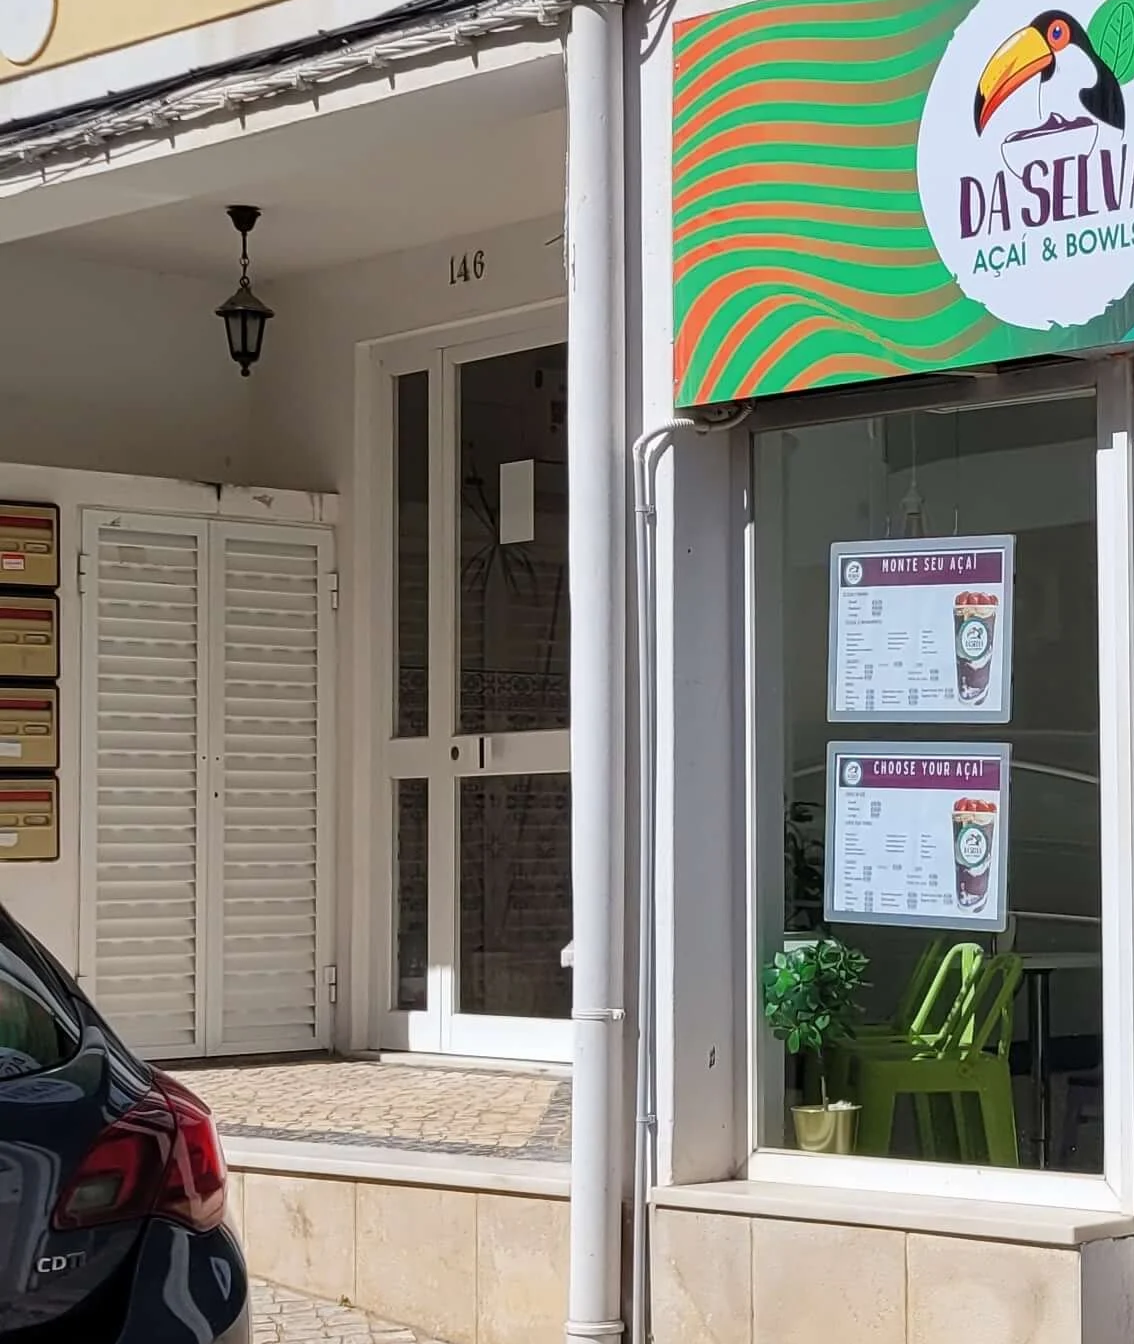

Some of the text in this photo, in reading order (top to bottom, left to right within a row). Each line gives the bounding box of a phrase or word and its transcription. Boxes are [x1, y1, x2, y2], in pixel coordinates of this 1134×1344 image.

[959, 169, 1012, 240] DA
[449, 249, 485, 285] 146
[972, 233, 1027, 278] AÇAÍ
[1041, 236, 1059, 262] &
[881, 552, 978, 575] MONTE SEU AÇAÍ
[873, 759, 984, 781] CHOOSE YOUR AÇAÍ
[37, 1250, 87, 1273] CDTI
